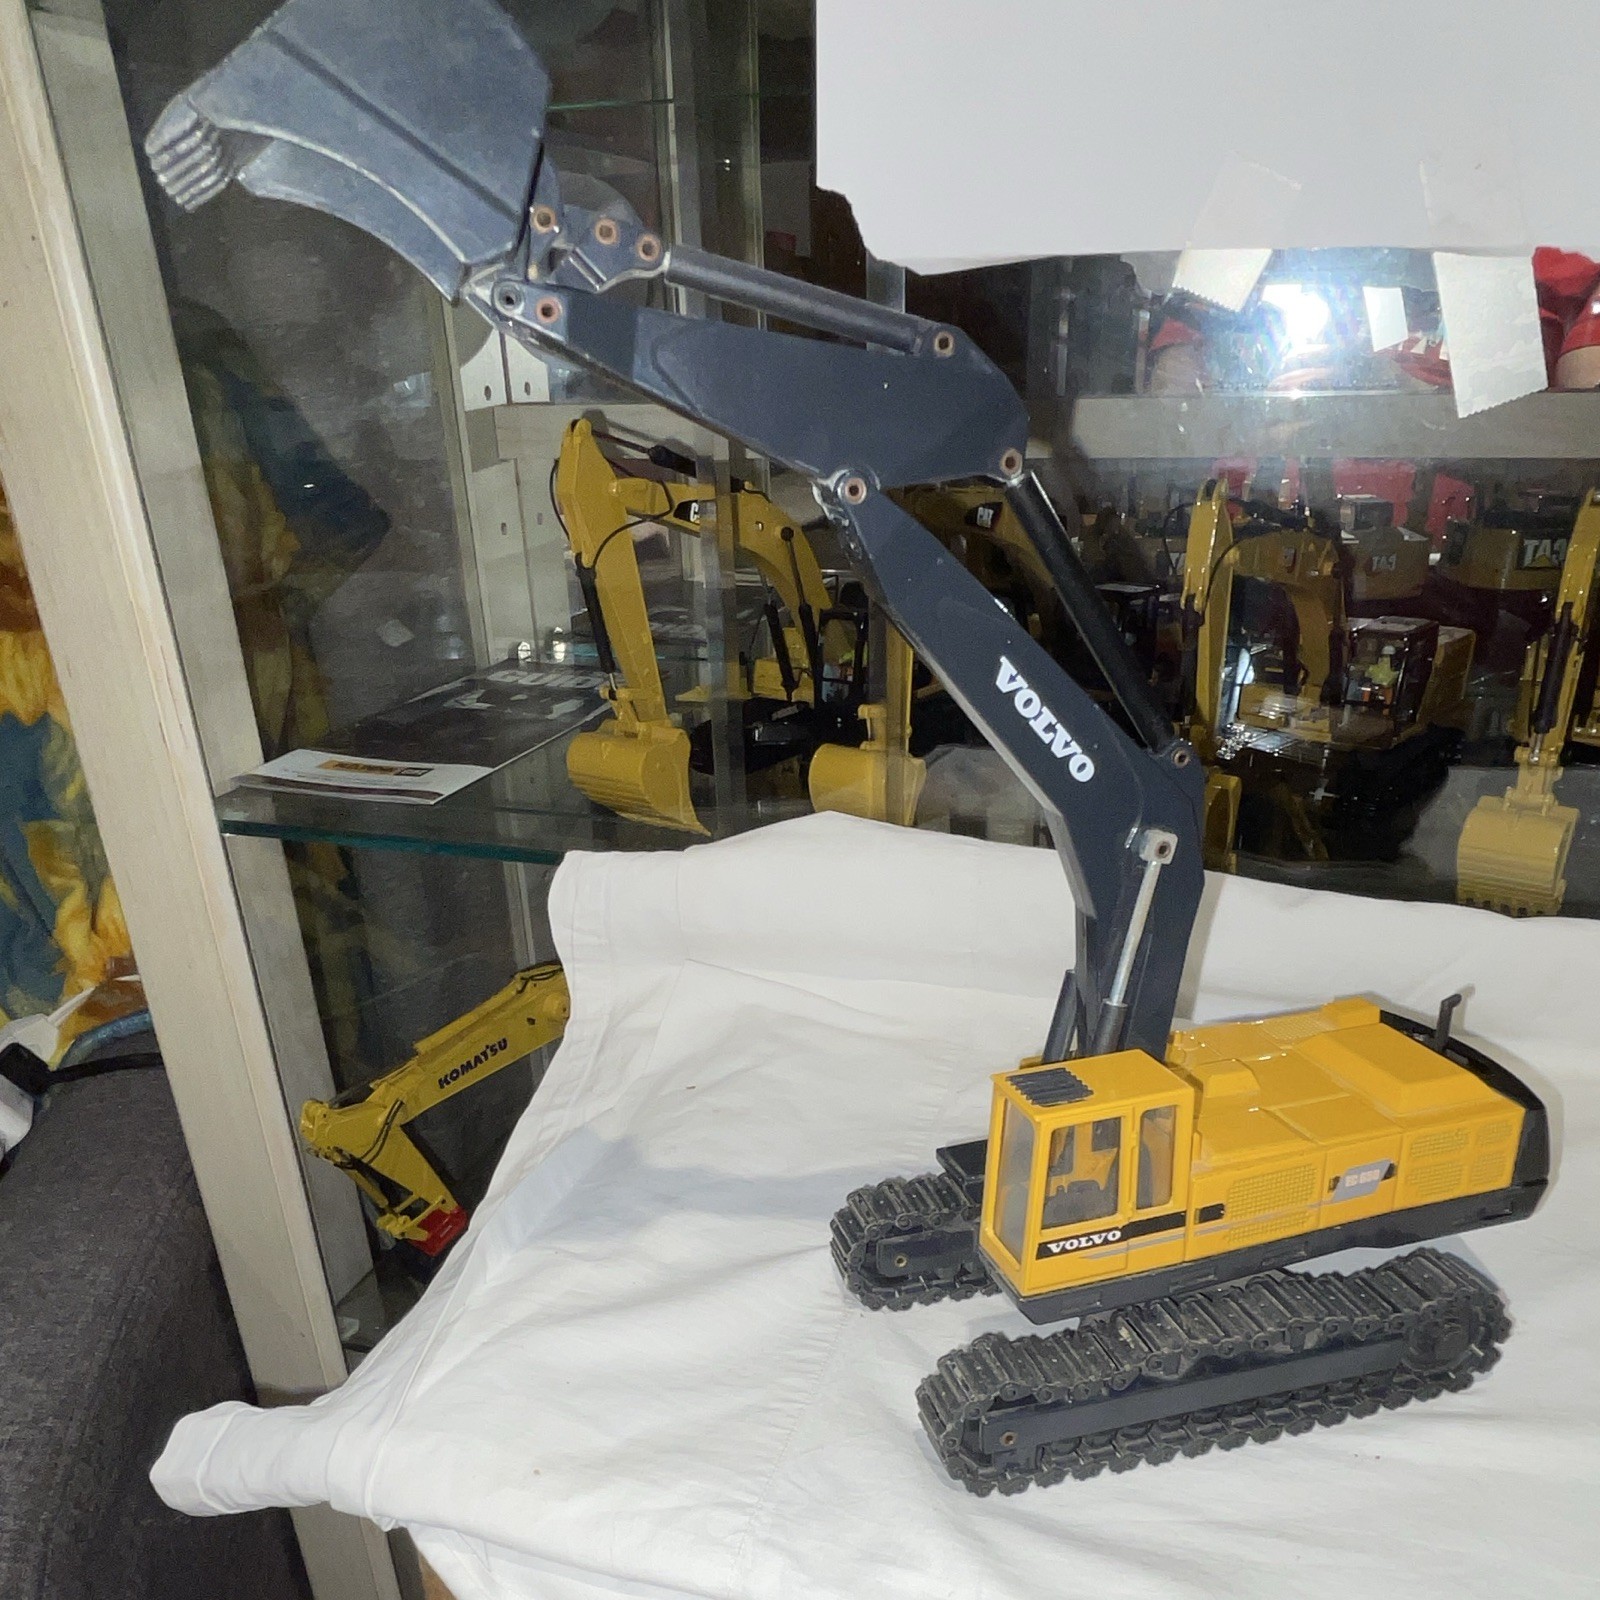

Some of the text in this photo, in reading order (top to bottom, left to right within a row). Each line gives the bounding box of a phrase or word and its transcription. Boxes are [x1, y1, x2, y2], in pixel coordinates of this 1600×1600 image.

[996, 655, 1095, 782] VOLVO
[438, 1037, 508, 1089] KOMATSU
[1047, 1230, 1121, 1253] VOLVO
